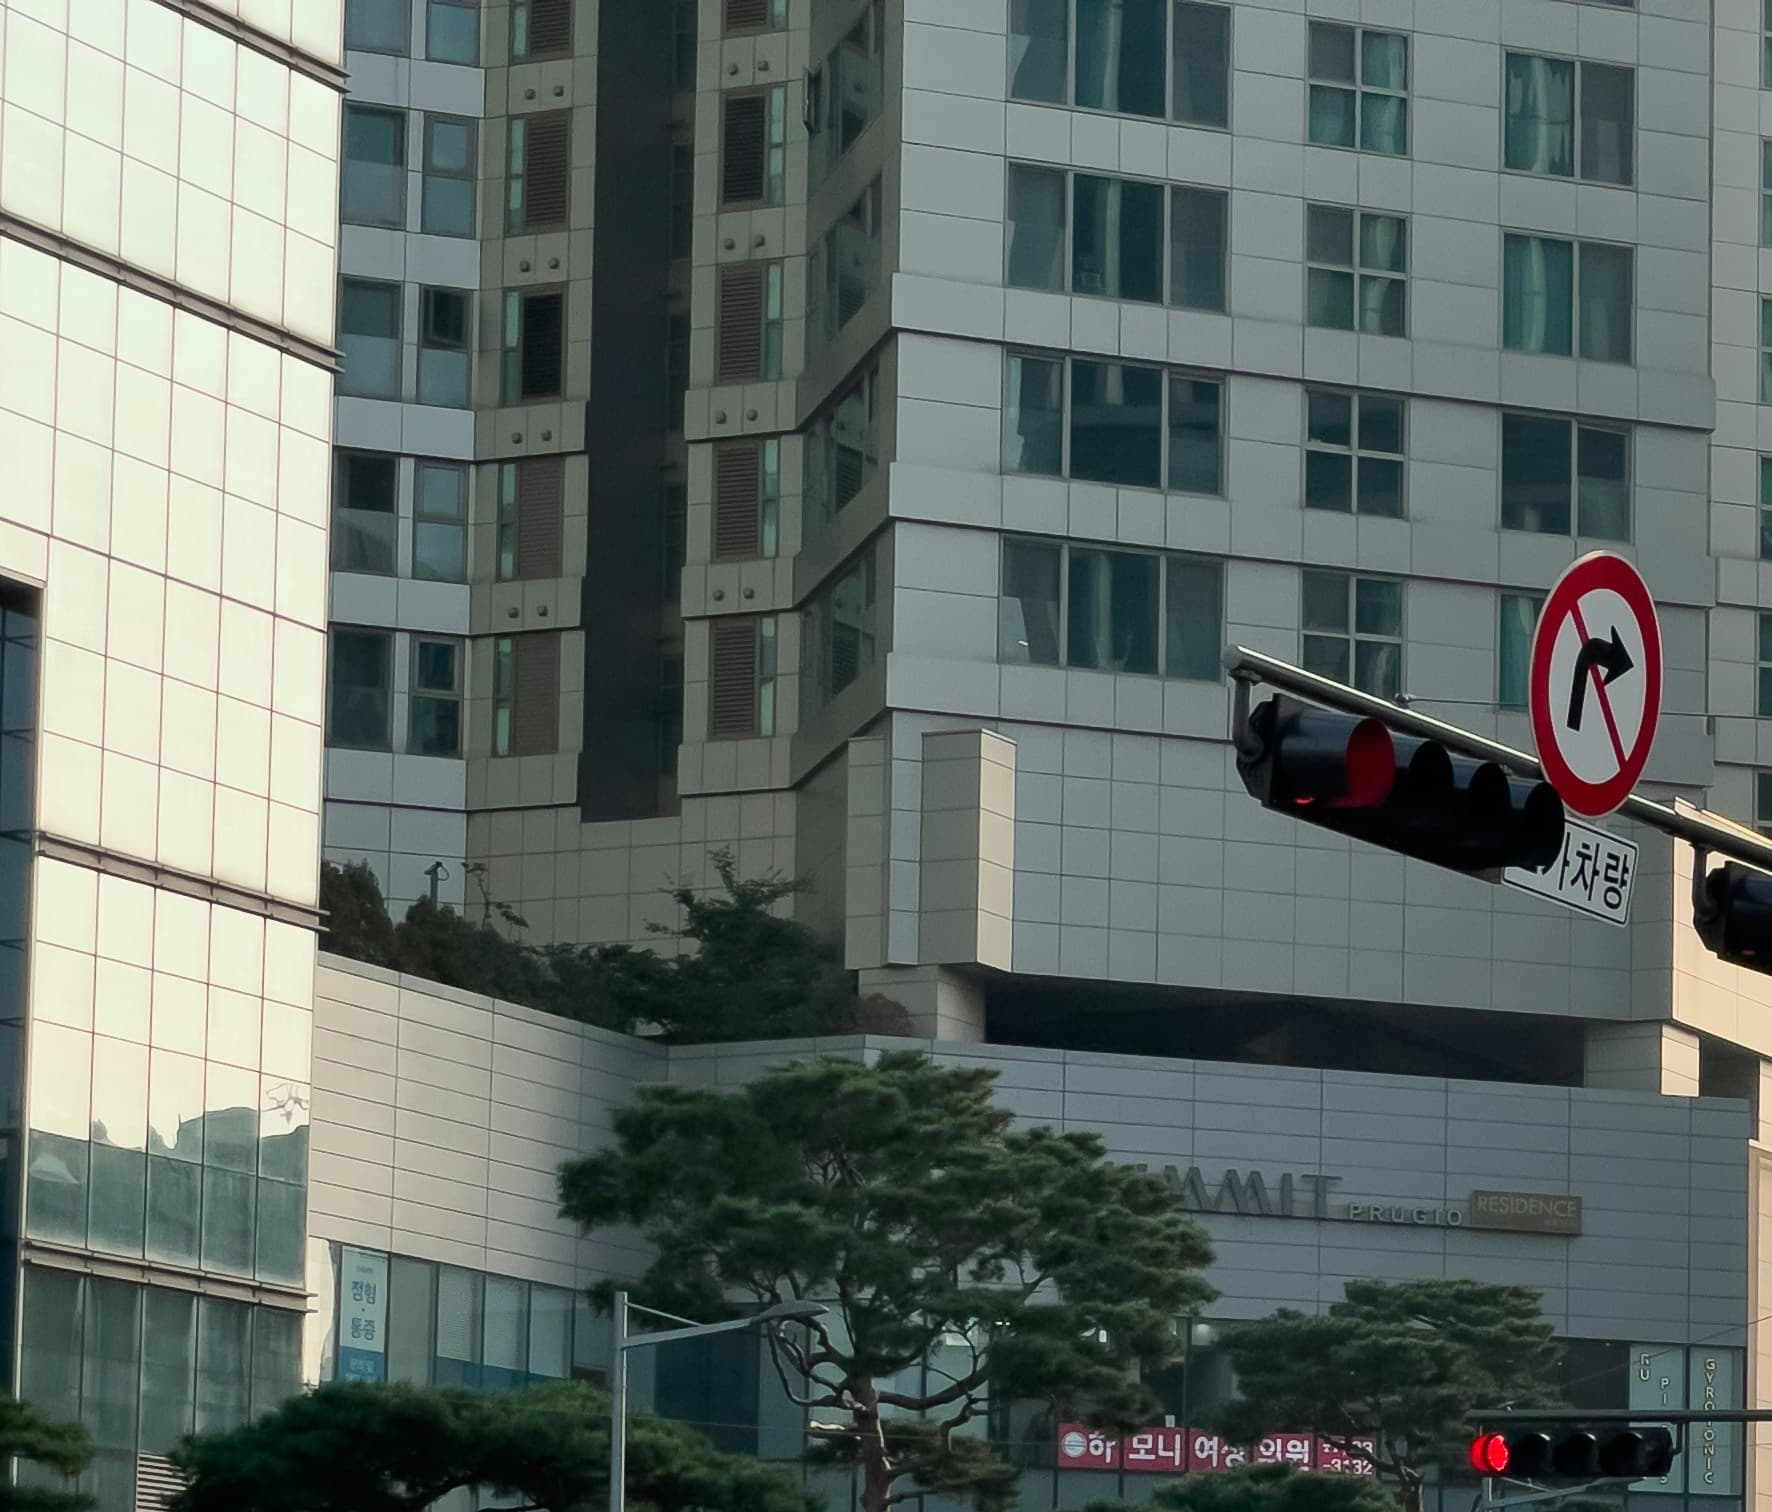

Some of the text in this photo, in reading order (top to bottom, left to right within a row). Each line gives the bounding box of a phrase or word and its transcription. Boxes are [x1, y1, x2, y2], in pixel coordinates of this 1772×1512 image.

[1162, 1164, 1578, 1226] MMIT PRUGIO RESIDENCE
[1703, 1358, 1716, 1484] GYROONIC
